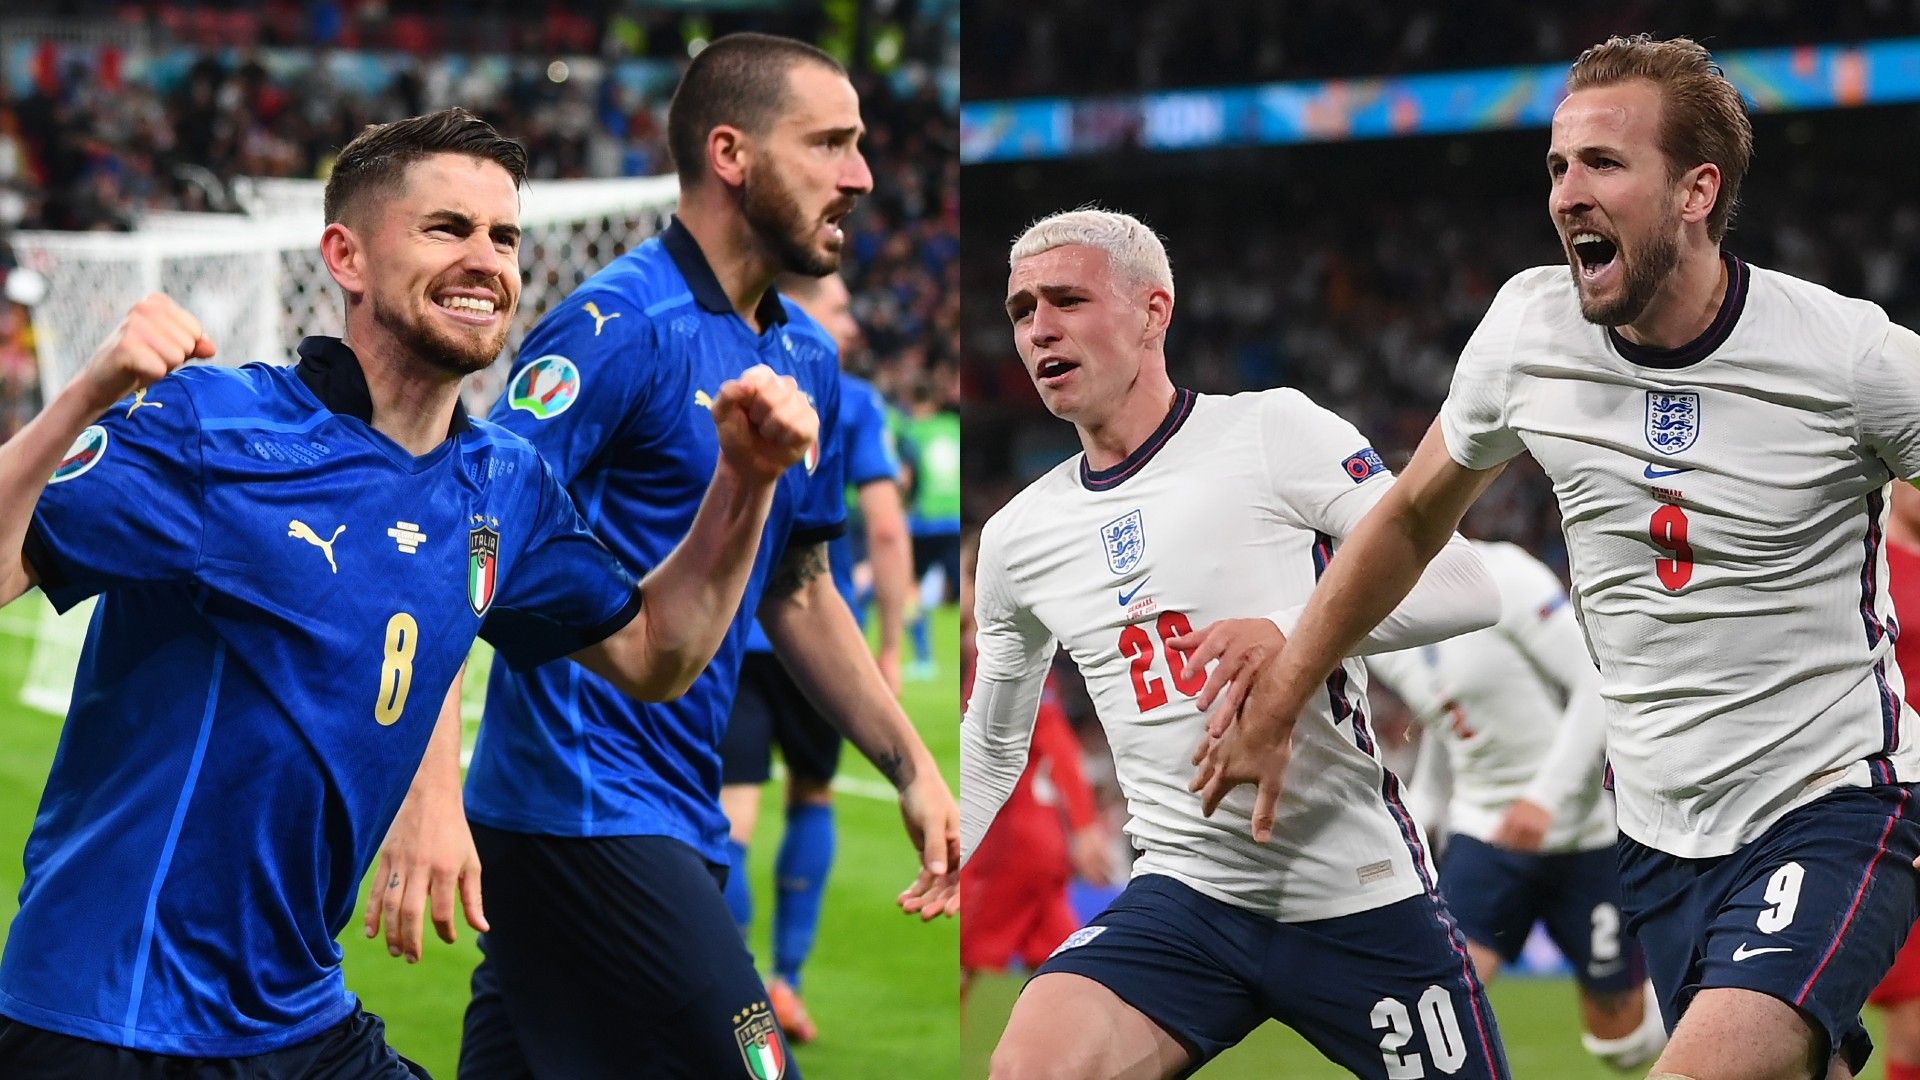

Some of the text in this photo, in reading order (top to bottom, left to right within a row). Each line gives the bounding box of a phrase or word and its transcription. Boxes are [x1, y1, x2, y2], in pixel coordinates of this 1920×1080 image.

[471, 534, 496, 550] ITALIA
[1650, 503, 1694, 591] 9
[374, 612, 418, 726] 8
[1590, 902, 1620, 961] 2
[1756, 861, 1806, 934] 9
[1370, 985, 1467, 1080] 20
